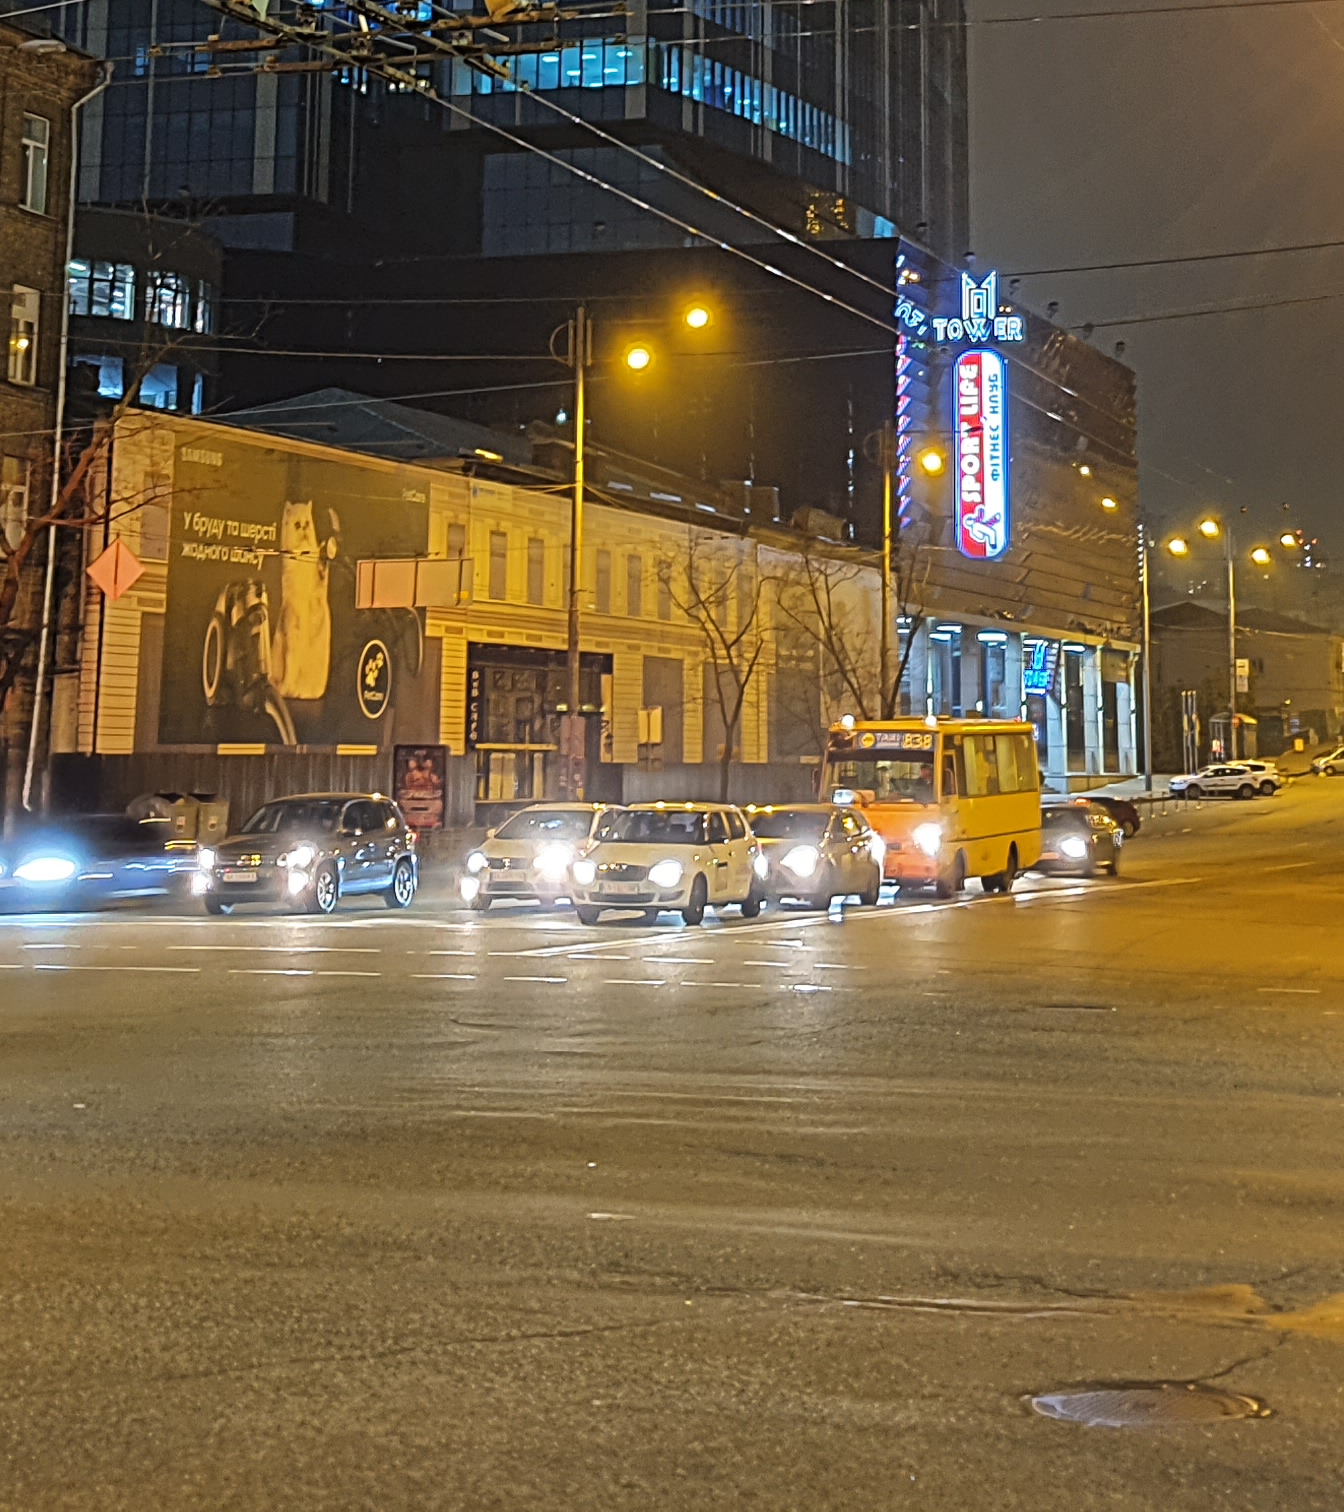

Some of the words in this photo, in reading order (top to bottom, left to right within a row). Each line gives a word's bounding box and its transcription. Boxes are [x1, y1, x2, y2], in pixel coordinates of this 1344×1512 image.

[933, 317, 1023, 342] TOWER
[959, 364, 980, 416] LIFE
[959, 420, 982, 503] SPORT
[989, 424, 1001, 482] ФІТНЕС
[184, 512, 192, 530] У
[193, 512, 225, 540] бруду
[227, 520, 239, 536] та
[240, 522, 277, 544] шерсті
[181, 543, 229, 561] жодного
